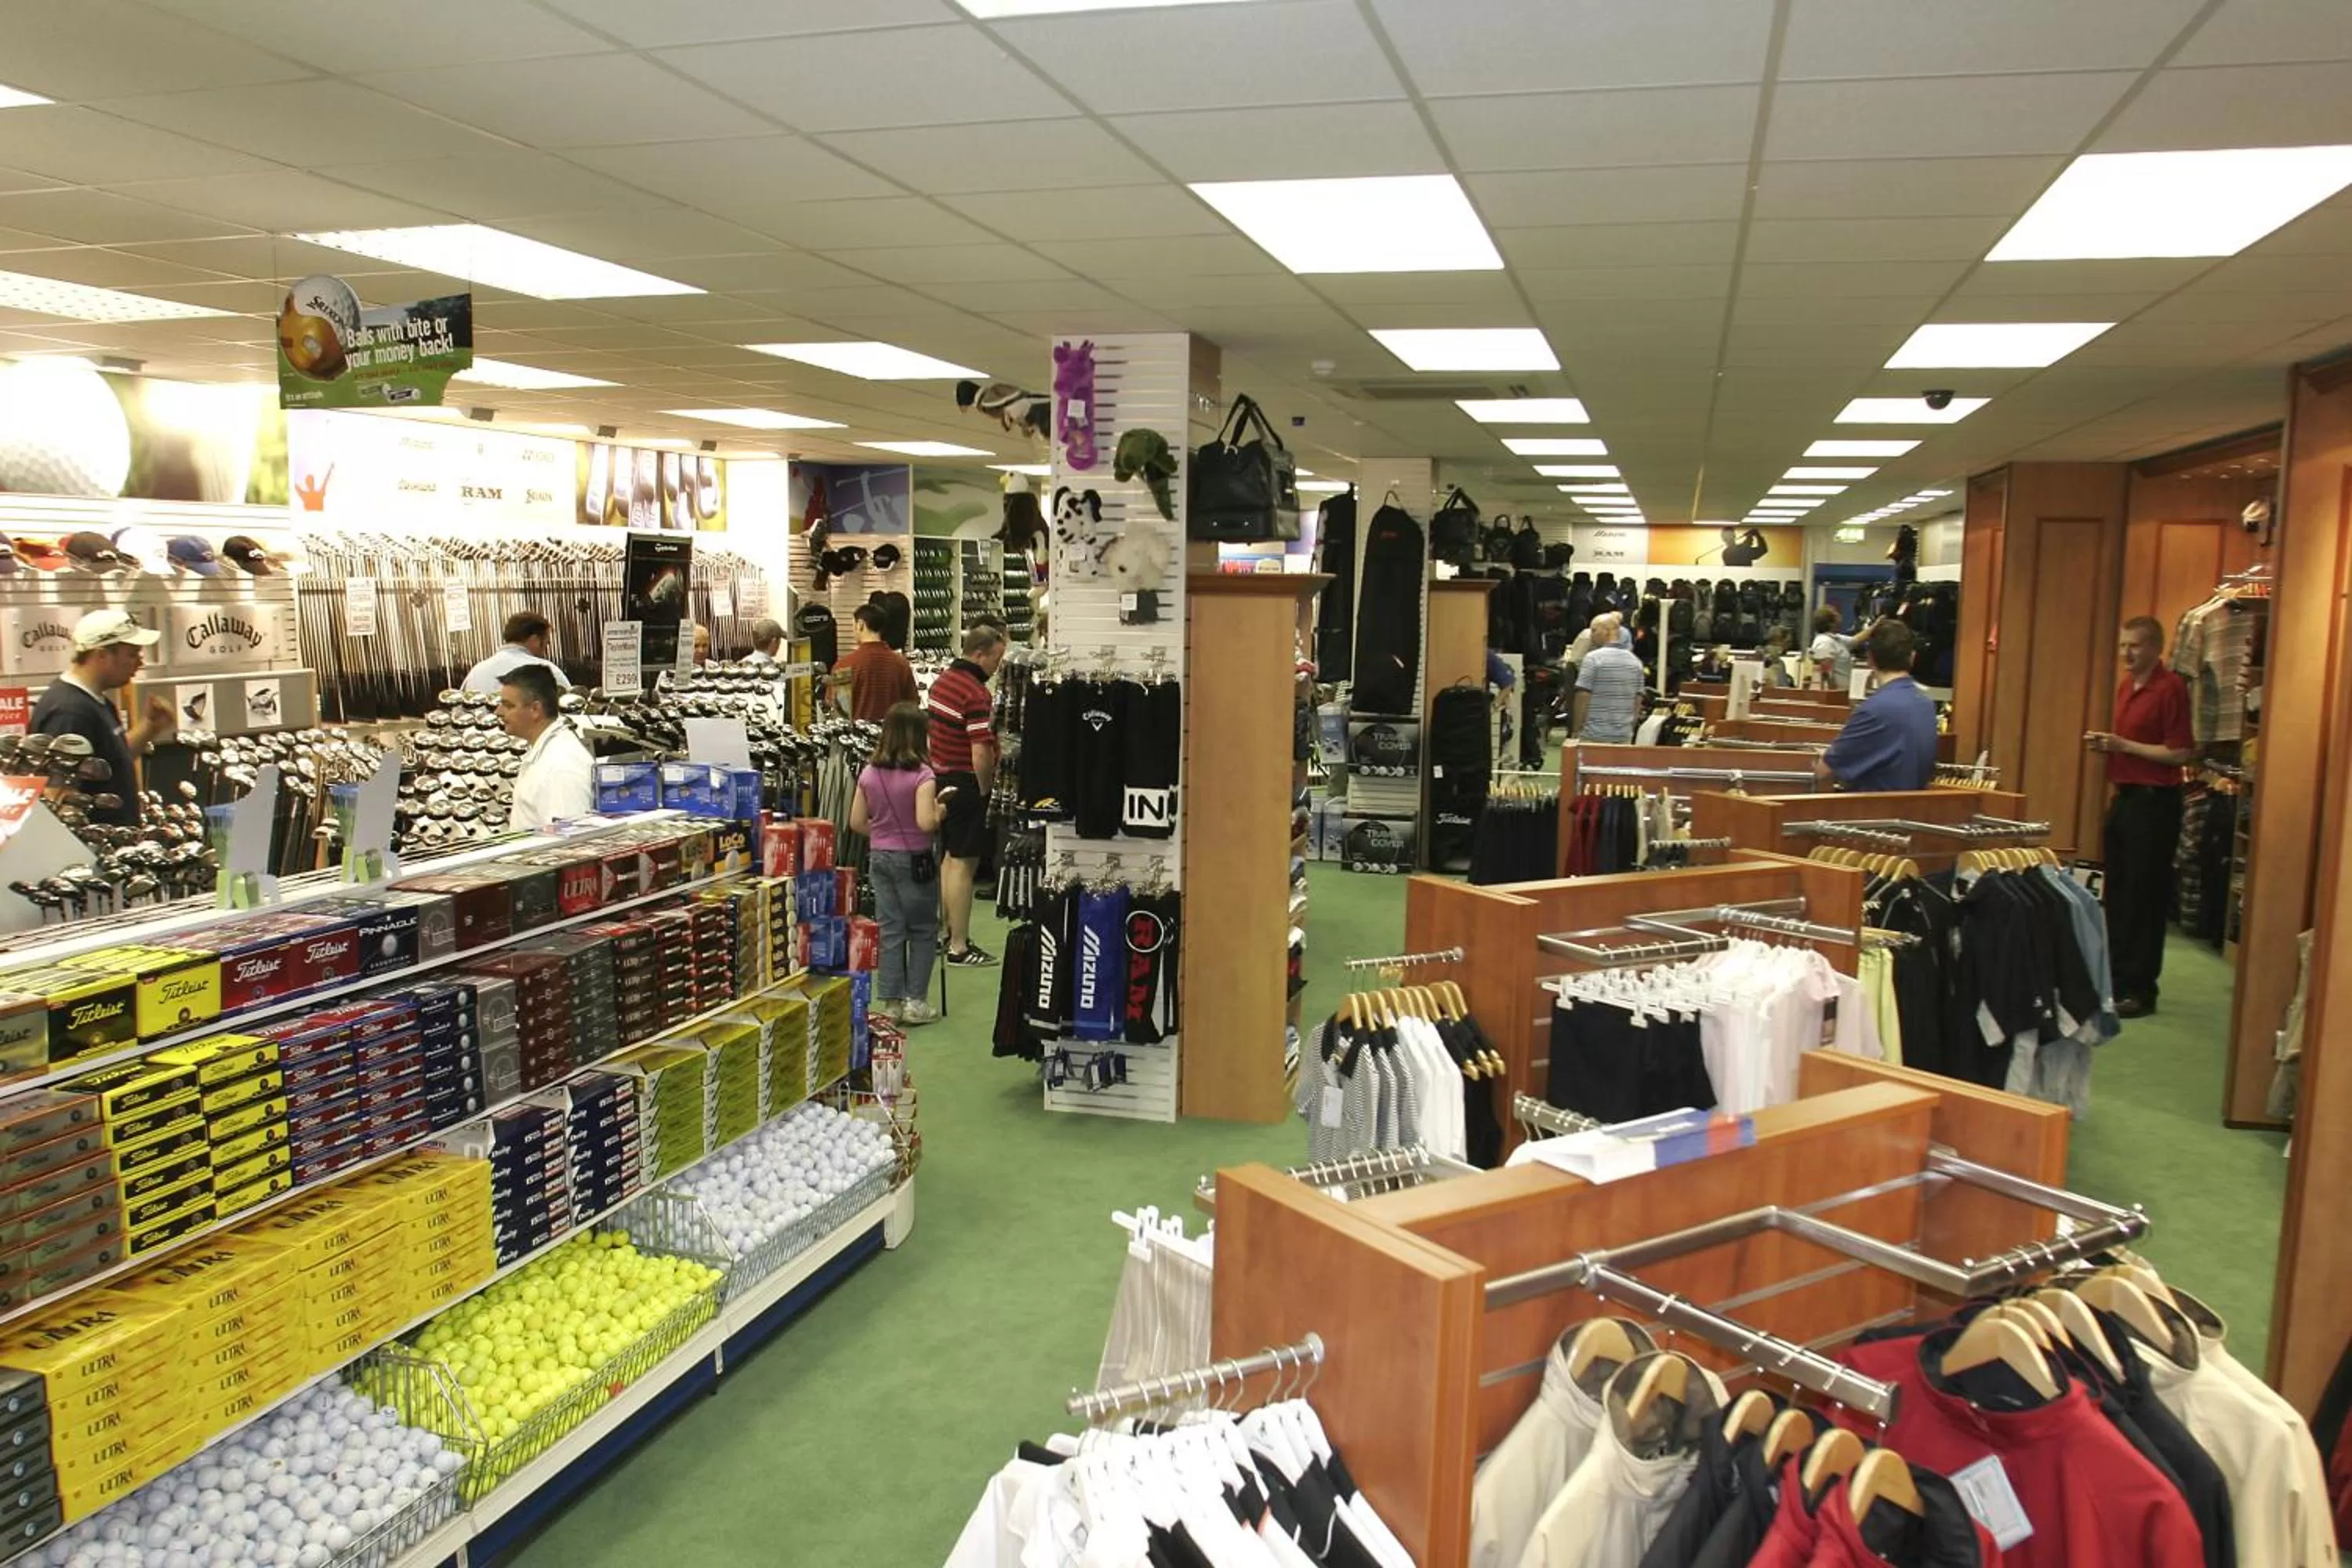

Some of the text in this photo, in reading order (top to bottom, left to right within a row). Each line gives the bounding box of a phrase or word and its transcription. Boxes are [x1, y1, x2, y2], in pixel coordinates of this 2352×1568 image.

[347, 317, 448, 348] Balls with bite or
[345, 350, 371, 372] your
[376, 343, 414, 364] money
[419, 333, 454, 357] back!
[461, 486, 503, 499] RAM
[23, 621, 73, 648] Callaw
[186, 612, 263, 649] Callaway
[209, 645, 243, 655] GOLF
[358, 917, 418, 937] PINNACLE
[304, 941, 350, 964] Titleist
[234, 958, 282, 982] Titleist
[158, 979, 209, 1004] Titleist
[67, 1001, 126, 1029] Titleist
[425, 1189, 448, 1205] ULTRA
[426, 1213, 451, 1229] ULTRA
[324, 1231, 351, 1250] ULTRA
[429, 1236, 452, 1253] ULTRA
[329, 1259, 357, 1277] ULTRA
[430, 1259, 452, 1276] ULTRA
[209, 1288, 239, 1308] ULTRA
[331, 1283, 358, 1302] ULTRA
[431, 1283, 455, 1299] ULTRA
[215, 1316, 245, 1337] ULTRA
[336, 1308, 362, 1327] ULTRA
[23, 1310, 117, 1350] ULTRA
[216, 1342, 246, 1364] ULTRA
[337, 1333, 364, 1352] ULTRA
[82, 1353, 116, 1377] ULTRA
[220, 1369, 251, 1390] ULTRA
[85, 1382, 119, 1406] ULTRA
[224, 1395, 254, 1417] ULTRA
[87, 1412, 122, 1436] ULTRA
[93, 1439, 127, 1465] ULTRA
[100, 1468, 134, 1494] ULTRA
